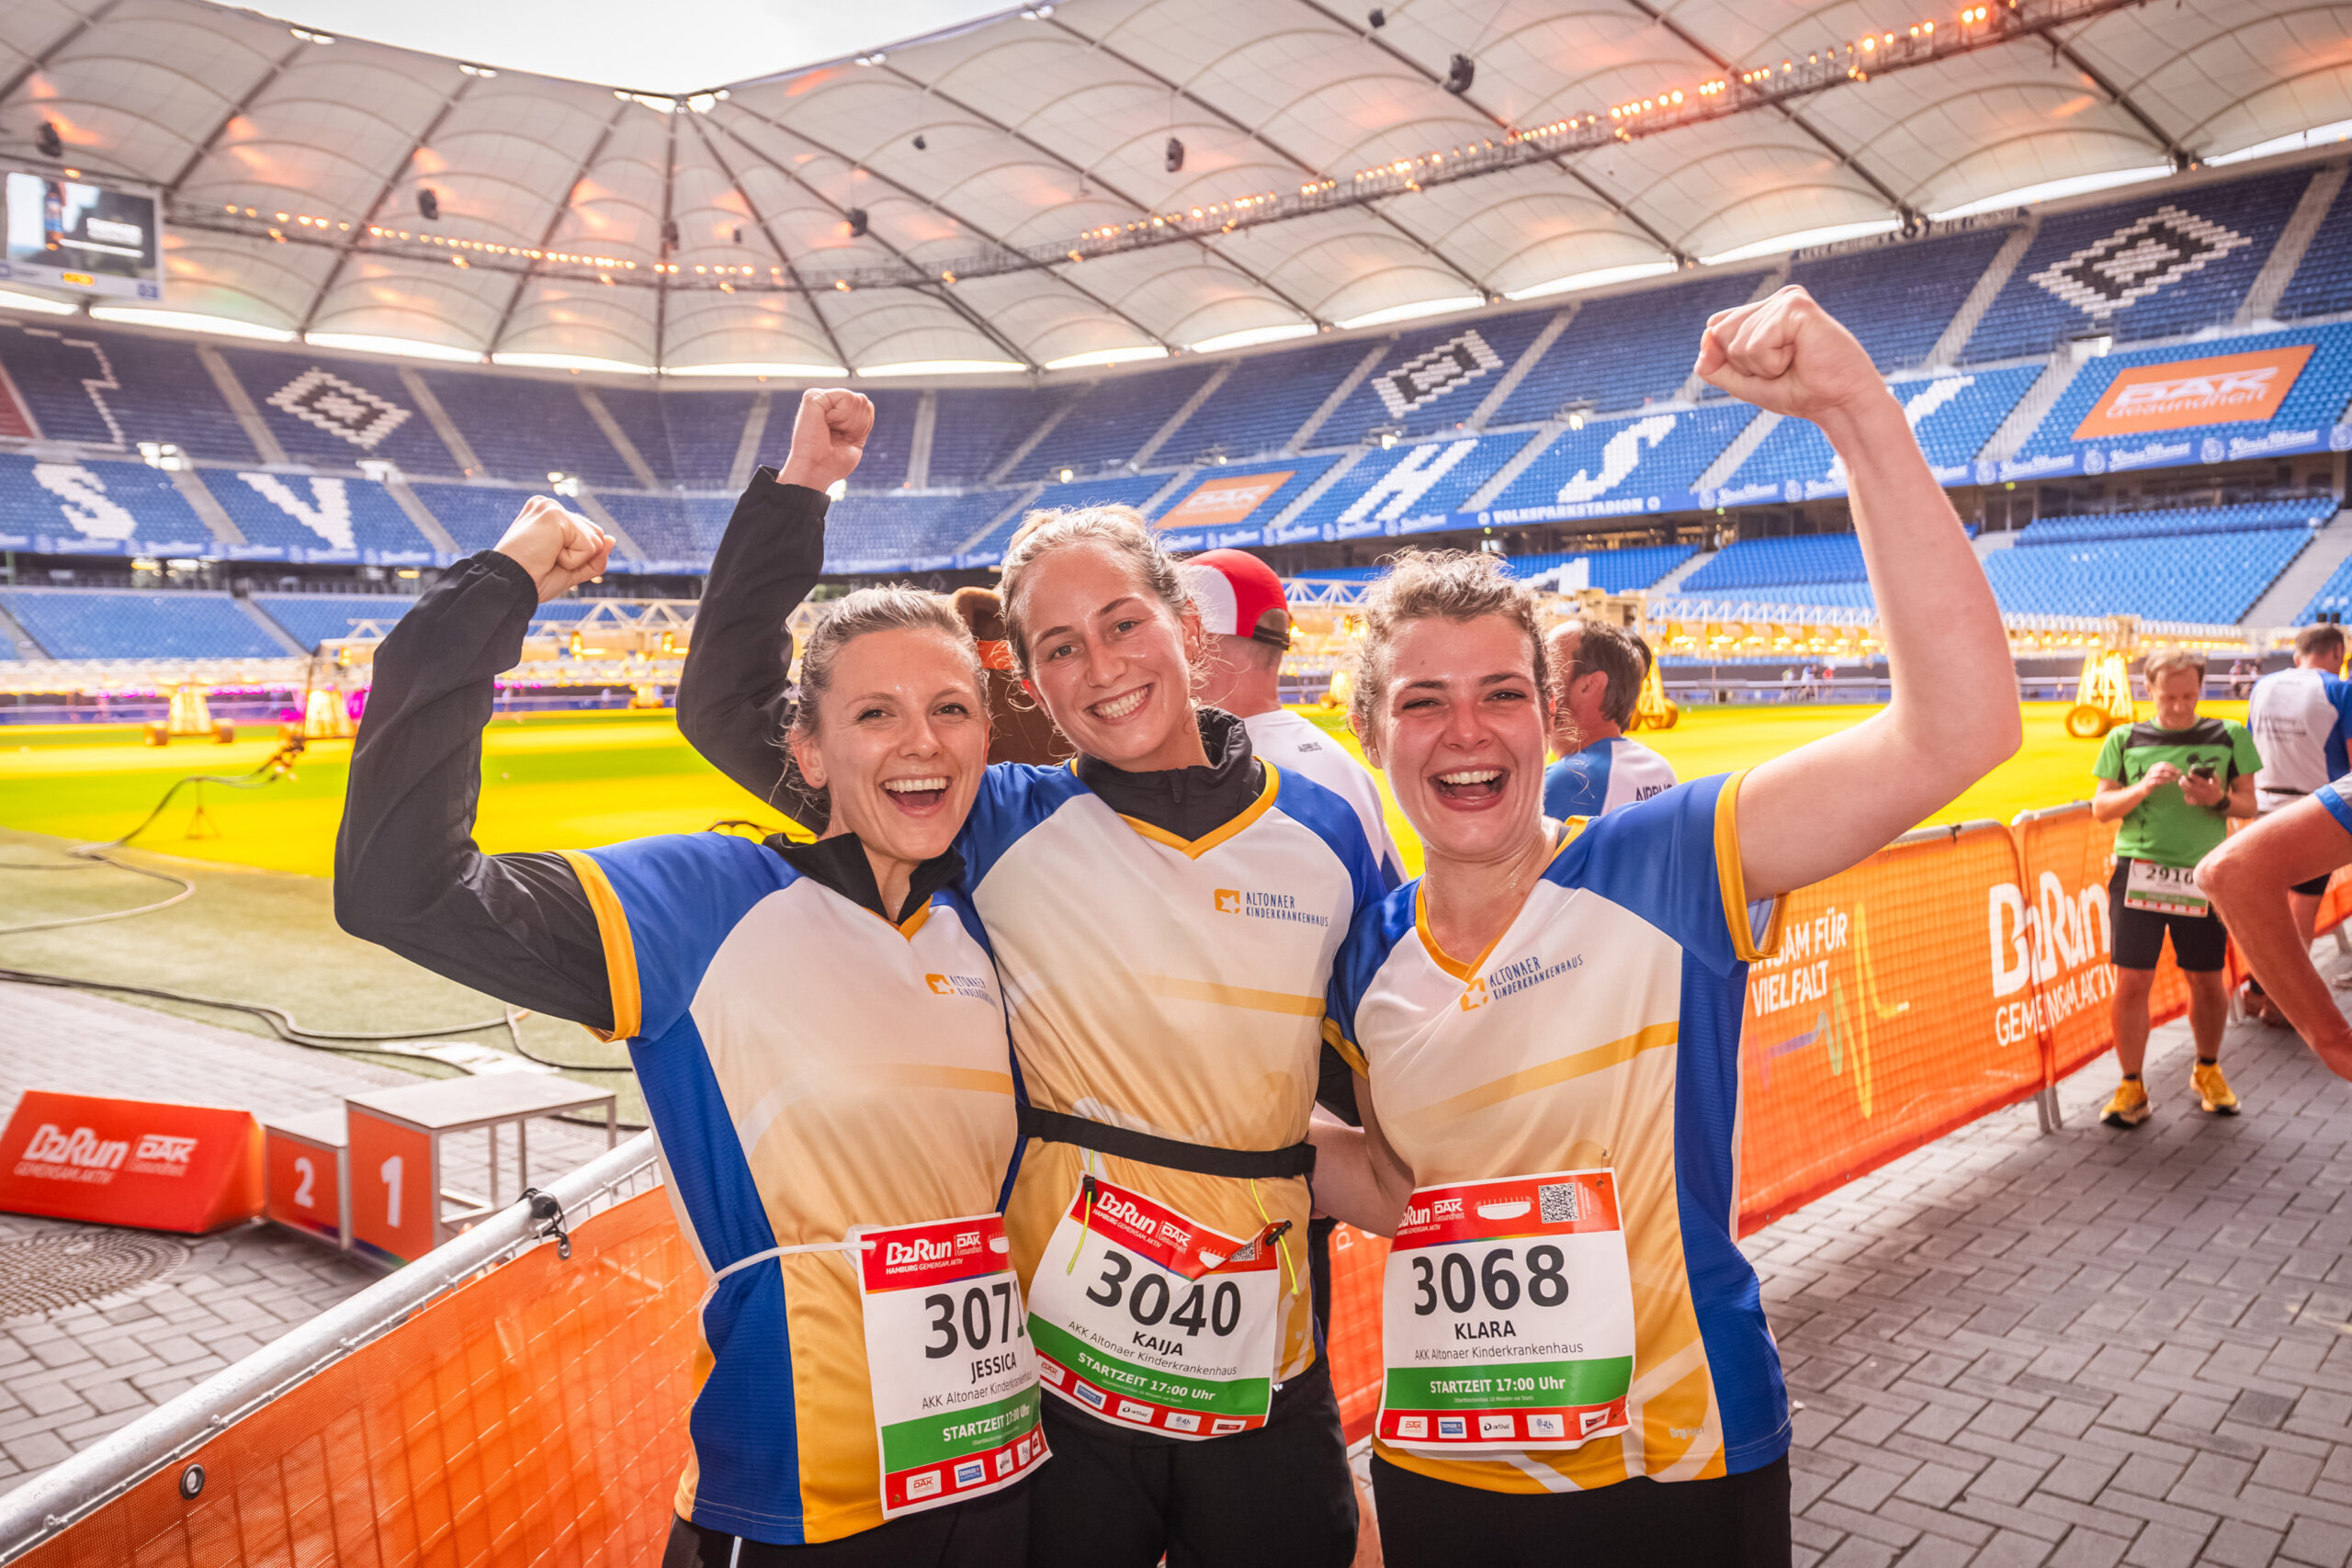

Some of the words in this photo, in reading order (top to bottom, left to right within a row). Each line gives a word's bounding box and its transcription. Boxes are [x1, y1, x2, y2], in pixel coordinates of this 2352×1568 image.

[1492, 497, 1644, 525] VOLKSPARKSTADION
[1246, 892, 1295, 908] ALTONAER
[1246, 906, 1329, 927] KINDERKRANKENHAUS
[1815, 906, 1848, 954] FÜR
[1989, 870, 2111, 998] B2Run
[1489, 956, 1542, 987] ALTONAER
[1492, 953, 1584, 1000] KINDERKRANKENHAUS
[1751, 959, 1829, 1018] VIELFALT
[22, 1123, 130, 1169] B2Run
[136, 1134, 198, 1163] DAK
[294, 1156, 314, 1209] 2
[380, 1155, 403, 1228] 1
[1092, 1208, 1118, 1225] HAMBURG
[1145, 1236, 1163, 1248] AKTIV
[1096, 1190, 1157, 1235] B2Run
[1160, 1221, 1192, 1247] DAK
[1397, 1205, 1430, 1228] 2Run
[1434, 1198, 1464, 1213] DAK
[885, 1238, 953, 1267] B2Run
[956, 1231, 982, 1247] DAK
[956, 1245, 982, 1257] Gesundheit
[886, 1263, 919, 1275] HAMBURG
[950, 1258, 964, 1266] AKTIV
[1411, 1244, 1569, 1316] 3068
[1085, 1249, 1241, 1337] 3040
[1132, 1330, 1184, 1357] KAIJA
[1454, 1319, 1517, 1341] KLARA
[1068, 1320, 1088, 1338] AKK
[1090, 1332, 1136, 1359] Altonaer
[1137, 1352, 1238, 1376] Kinderkrankenhaus
[1414, 1348, 1430, 1361] AKK
[1431, 1347, 1470, 1360] Altonaer
[1471, 1340, 1584, 1359] Kinderkrankenhaus
[971, 1351, 1017, 1384] JESSICA
[1077, 1351, 1148, 1388] STARTZEIT
[1149, 1380, 1188, 1397] 17:00
[1192, 1388, 1216, 1402] Uhr
[1430, 1379, 1492, 1393] STARTZEIT
[1496, 1377, 1535, 1393] 17:00
[1538, 1375, 1566, 1391] Uhr
[922, 1394, 943, 1410] AKK
[946, 1388, 989, 1405] Altonaer
[943, 1414, 1005, 1442] STARTZEIT
[1005, 1408, 1020, 1426] 17:00
[1020, 1403, 1030, 1418] Uhr
[913, 1475, 934, 1489] DAK
